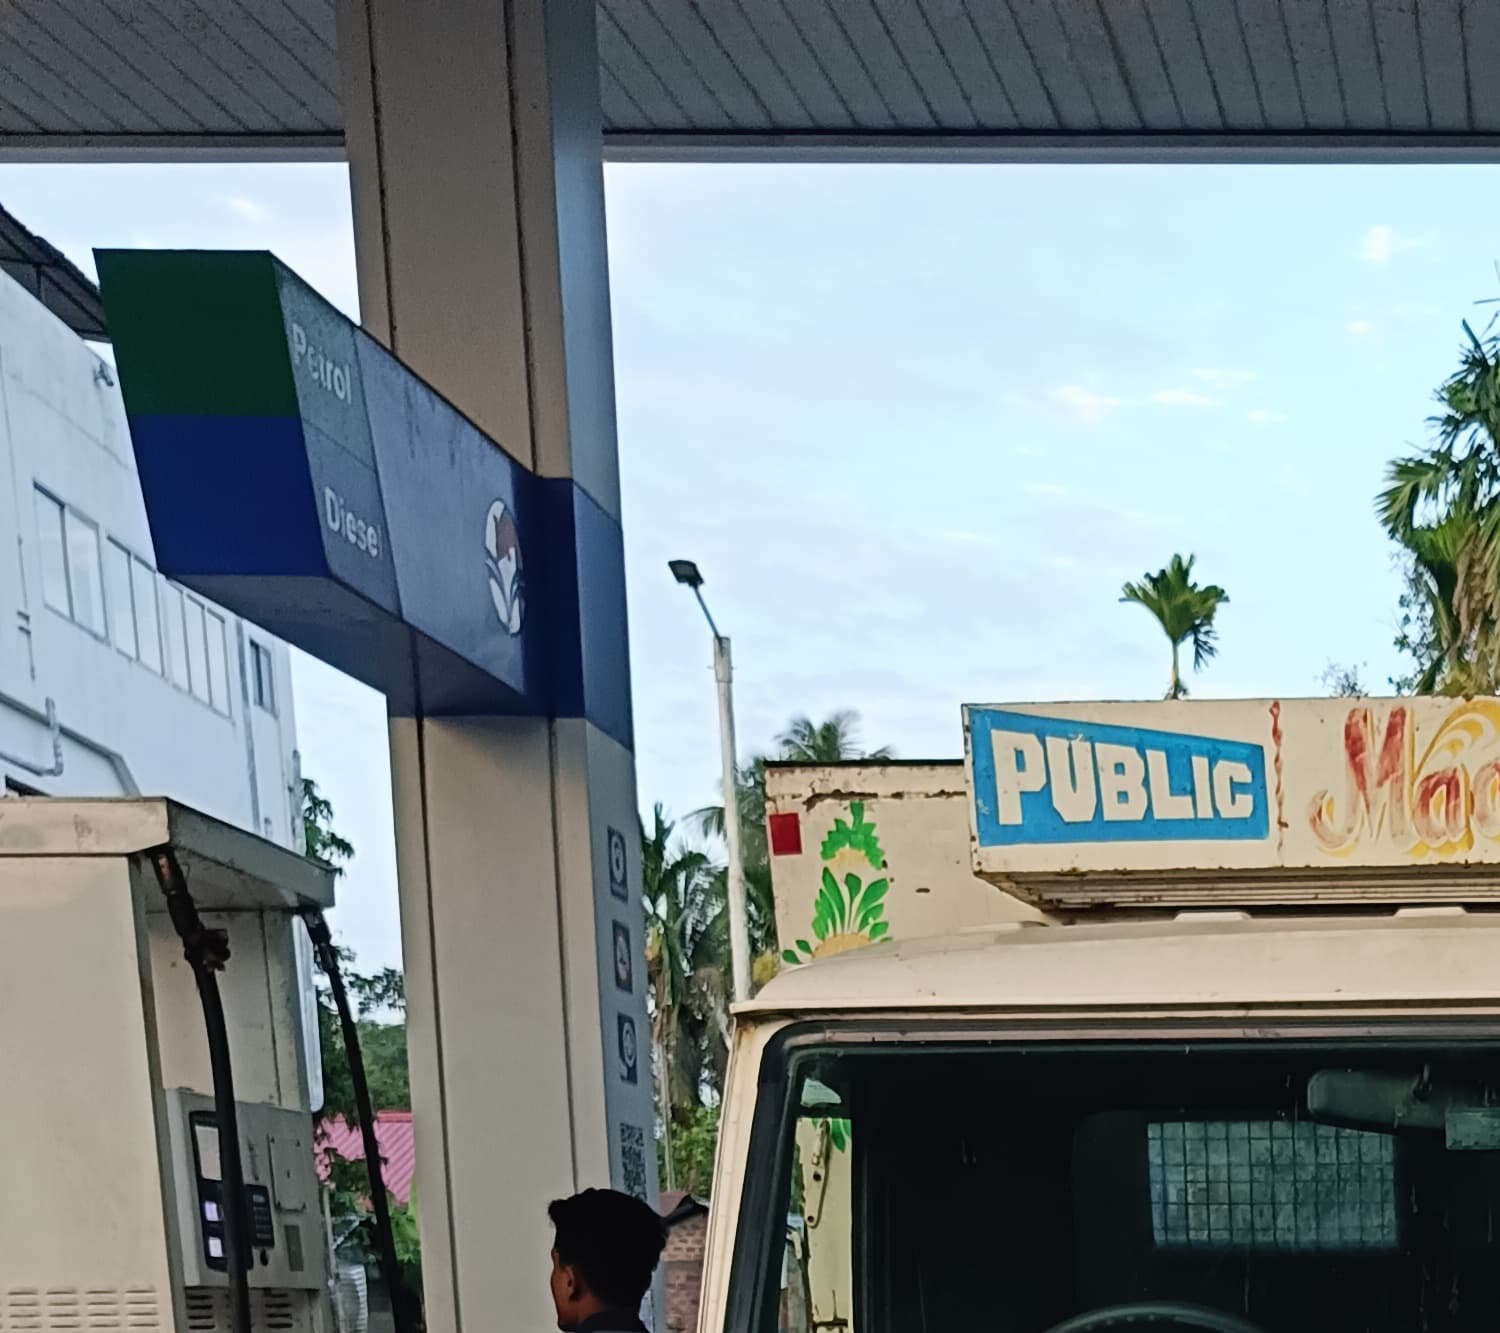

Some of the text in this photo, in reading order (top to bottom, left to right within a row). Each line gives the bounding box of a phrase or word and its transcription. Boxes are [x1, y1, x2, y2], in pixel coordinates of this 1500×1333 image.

[291, 323, 352, 403] Petrol
[323, 486, 384, 560] Diesel
[990, 728, 1254, 826] PUBLIC
